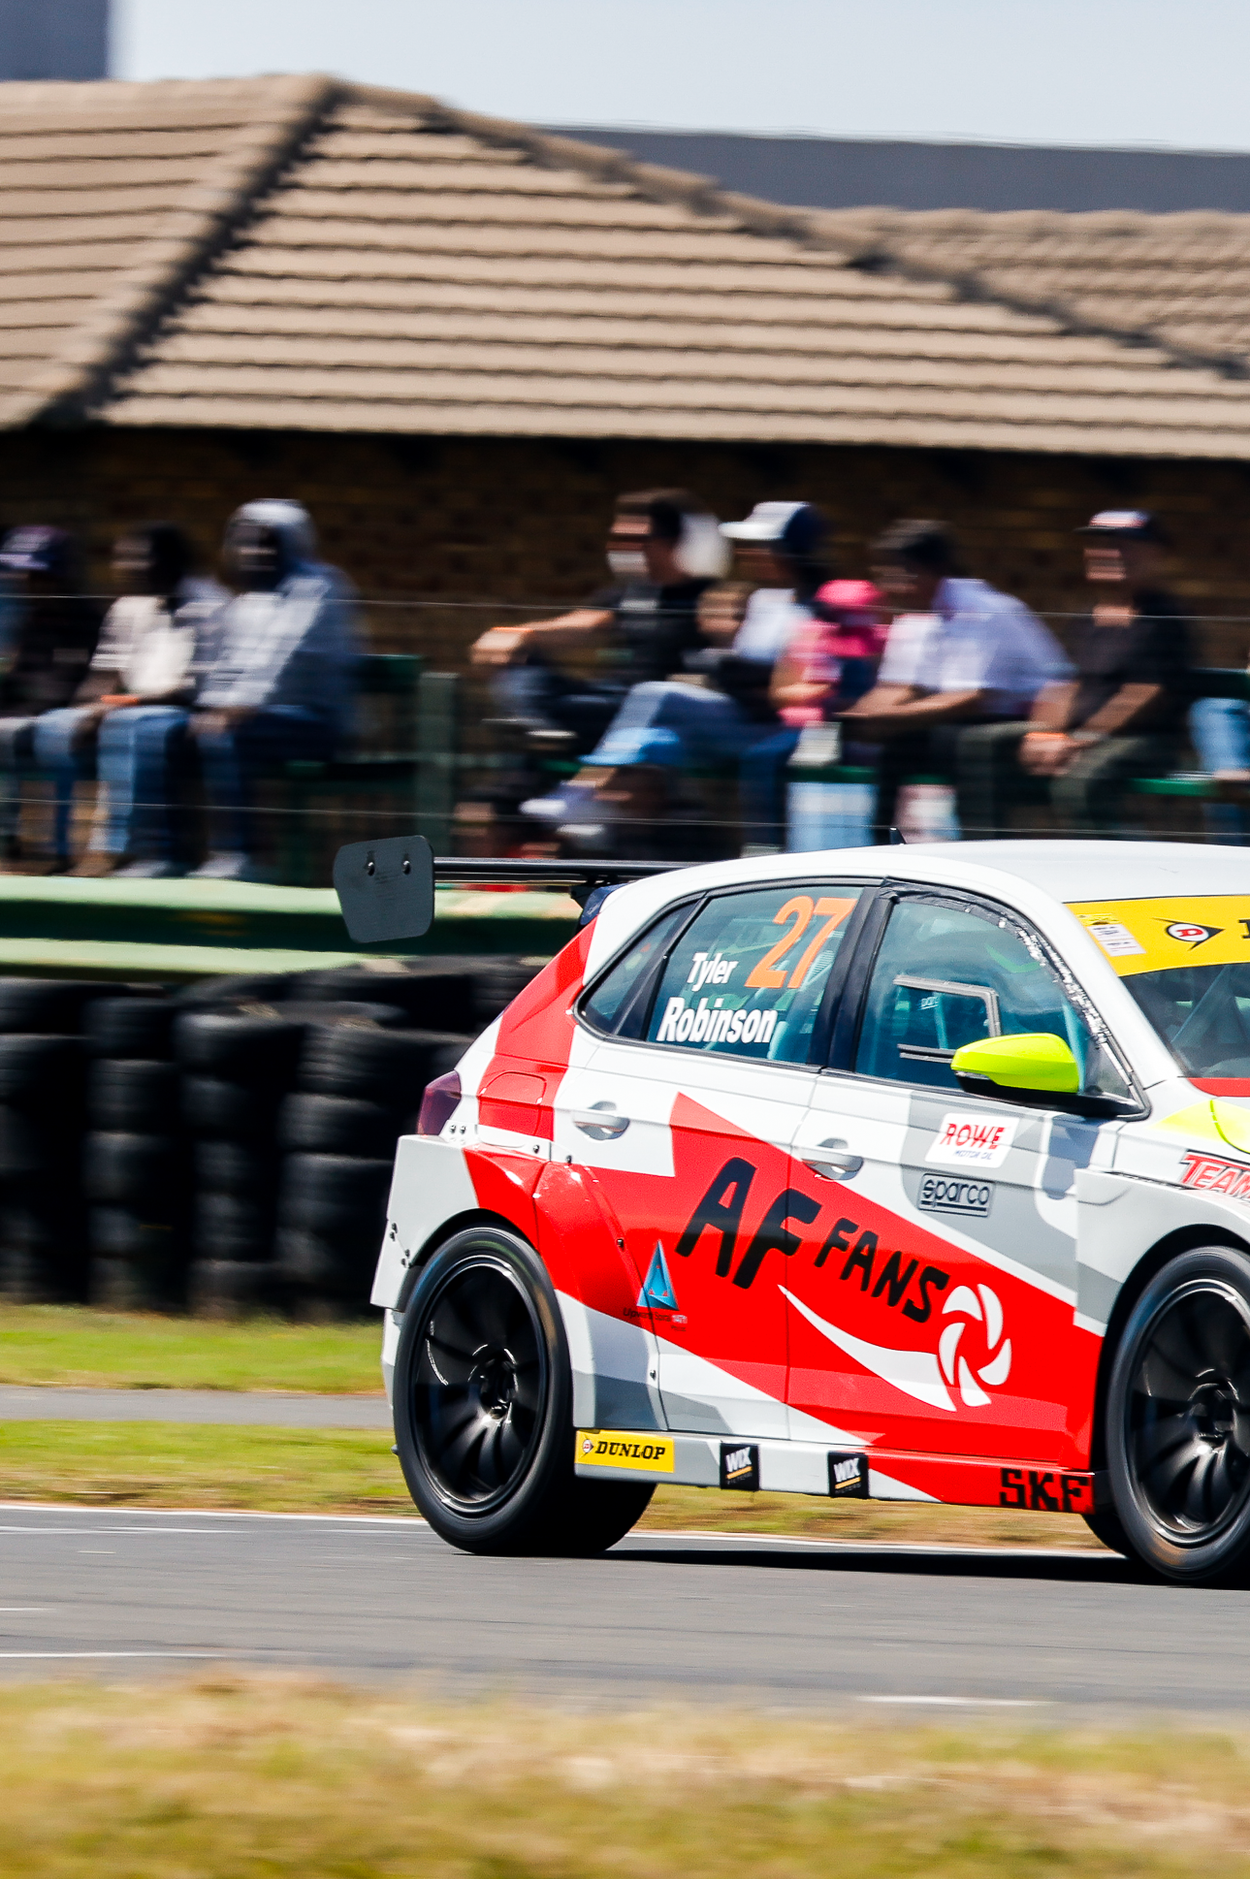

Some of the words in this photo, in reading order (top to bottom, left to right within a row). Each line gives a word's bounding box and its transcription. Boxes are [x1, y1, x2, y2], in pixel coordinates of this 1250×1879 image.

[744, 895, 857, 989] 27
[686, 952, 739, 992] Tyler
[656, 996, 778, 1044] Robinson
[939, 1122, 1006, 1150] ROWE
[921, 1179, 990, 1206] sparco
[675, 1156, 823, 1290] AF
[813, 1217, 950, 1324] FANS
[595, 1440, 666, 1460] DUNLOP
[725, 1446, 753, 1473] WIX
[833, 1457, 861, 1483] WIX
[999, 1467, 1089, 1513] SKF
